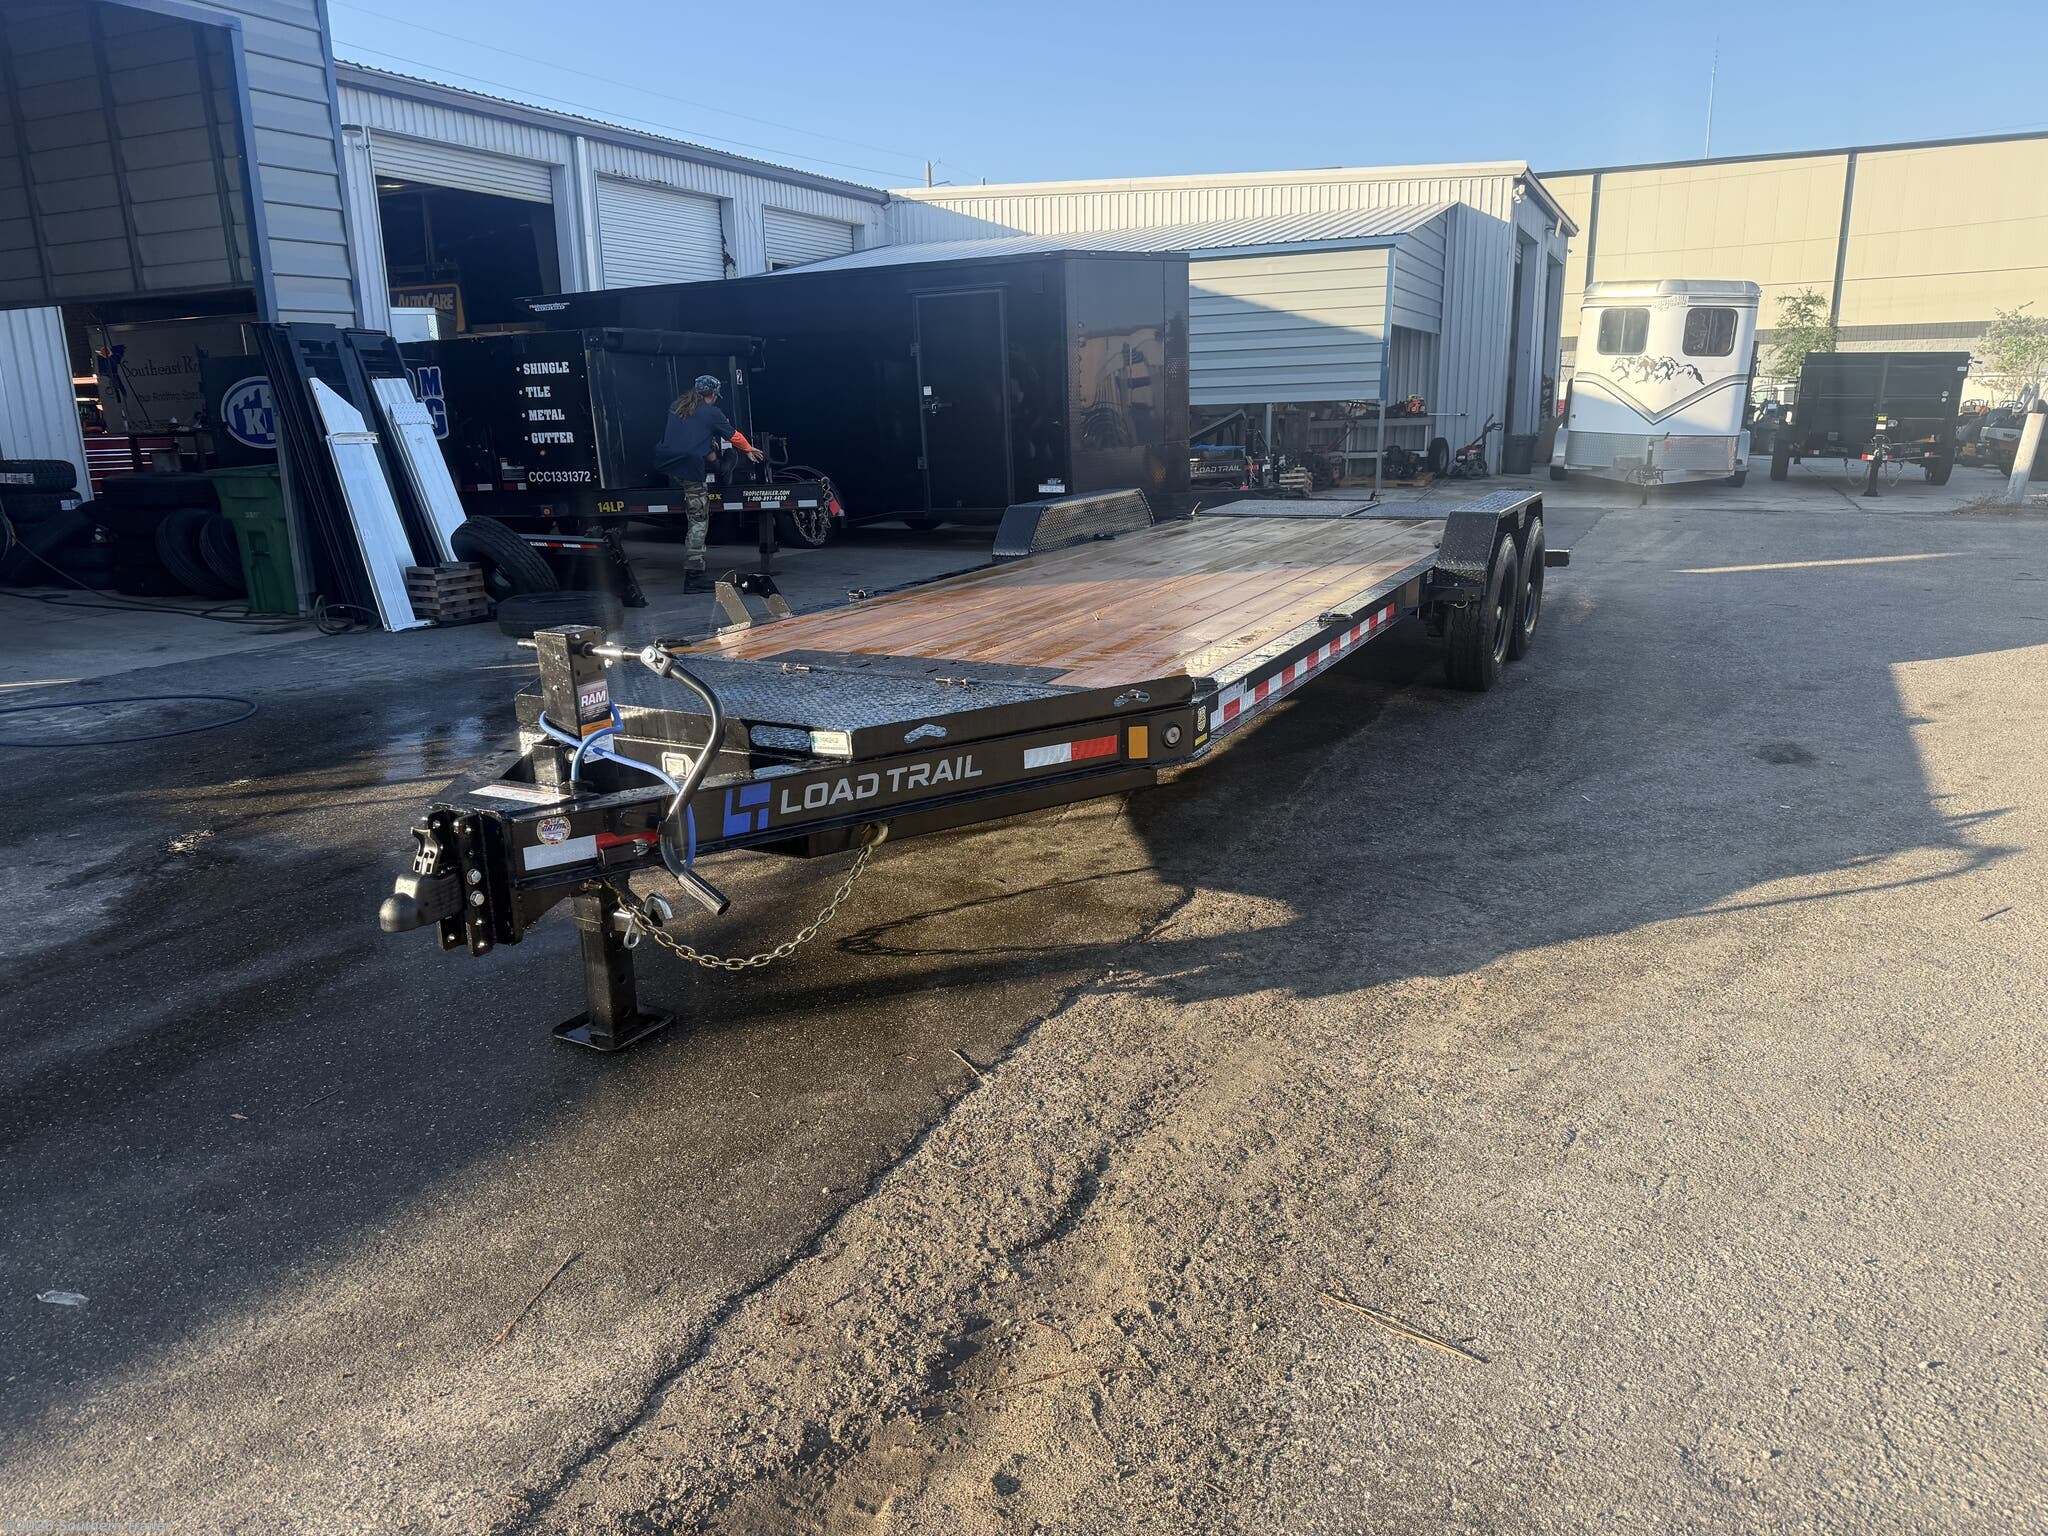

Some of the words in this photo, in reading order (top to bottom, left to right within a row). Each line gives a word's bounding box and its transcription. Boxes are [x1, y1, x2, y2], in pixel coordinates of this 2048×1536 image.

[121, 357, 181, 378] Southeast
[523, 361, 570, 375] SHINGLE
[525, 385, 551, 398] TILE
[528, 408, 565, 421] METAL
[531, 431, 575, 444] GUTTER
[1194, 465, 1217, 474] LOAD
[1218, 464, 1241, 472] TRAIL
[528, 470, 592, 483] CCC1331372
[597, 501, 625, 513] 14LP
[706, 493, 722, 501] ex
[581, 690, 606, 708] RAM
[780, 772, 880, 814] LOAD
[886, 754, 983, 792] TRAIL
